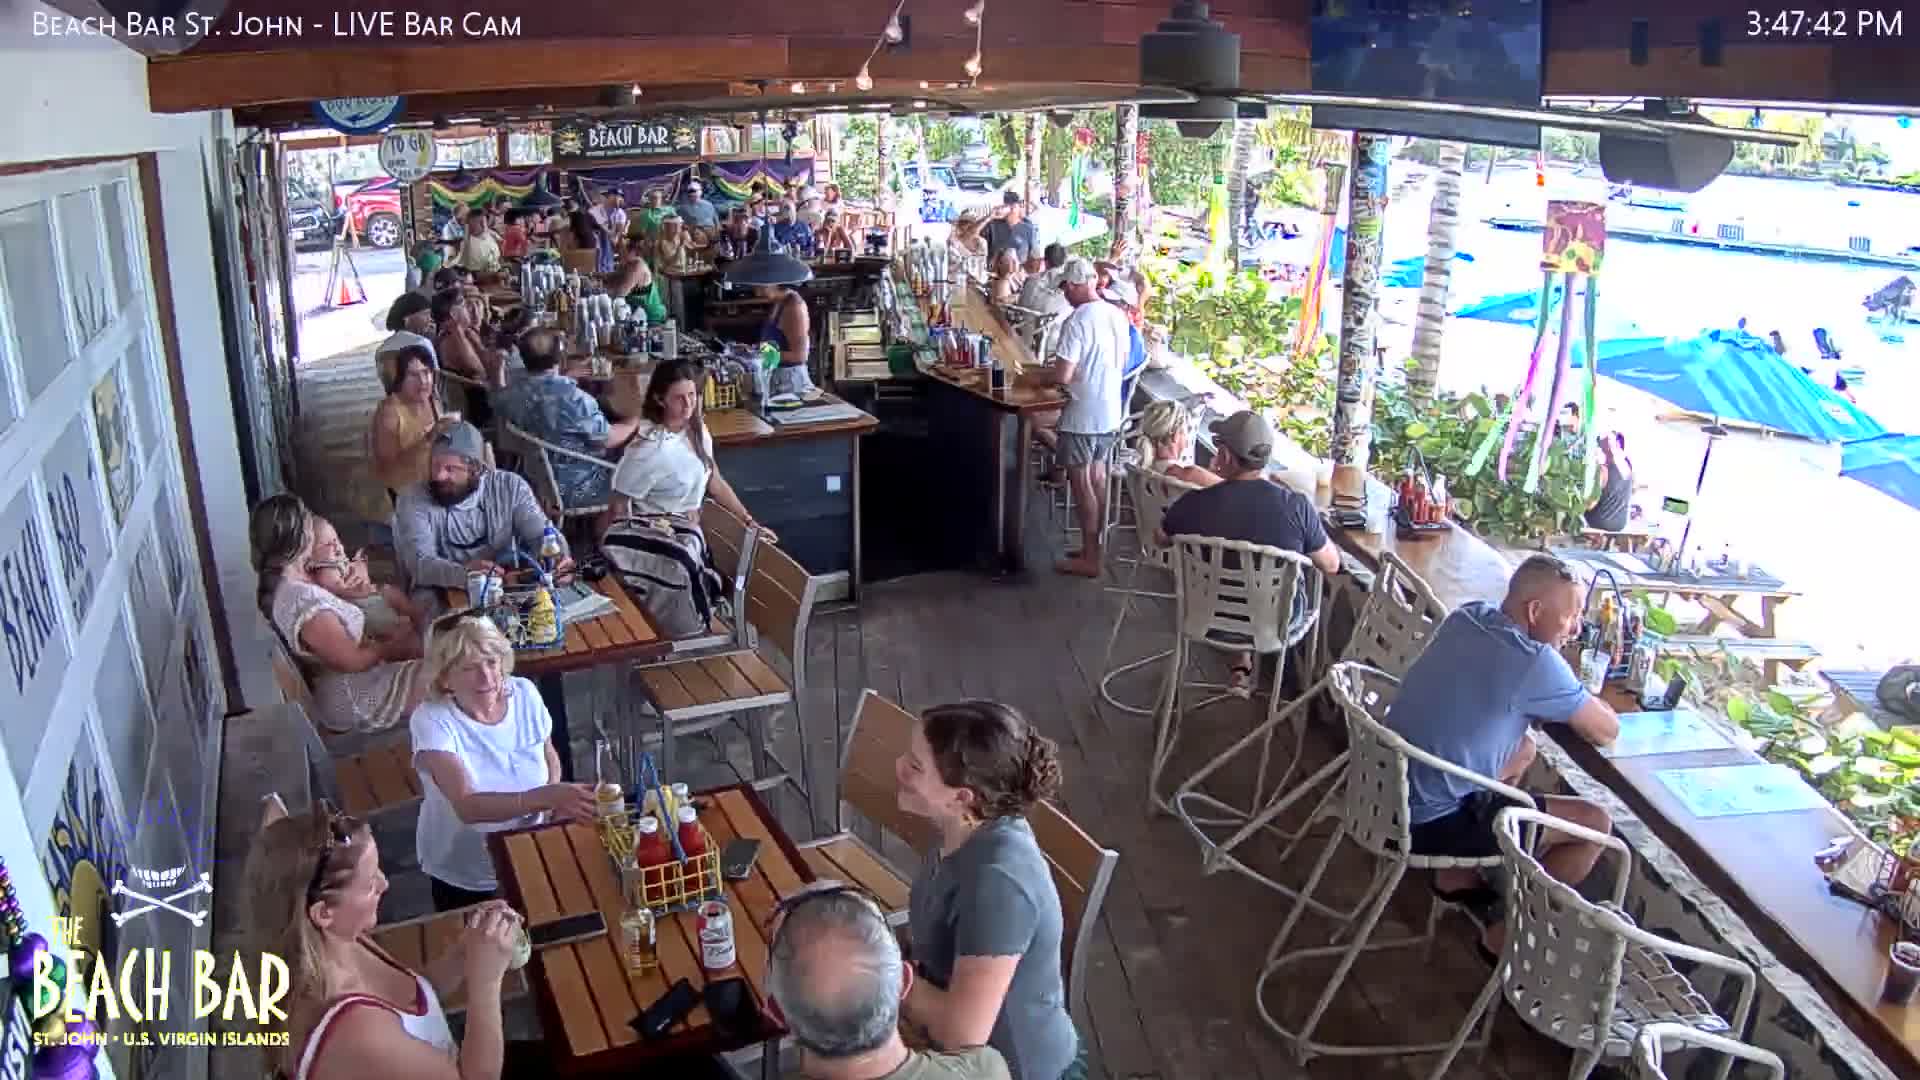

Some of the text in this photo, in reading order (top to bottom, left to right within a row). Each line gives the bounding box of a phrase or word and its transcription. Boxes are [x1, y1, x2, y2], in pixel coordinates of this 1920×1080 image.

[387, 131, 427, 154] TO GO
[588, 126, 669, 147] BEACH BAR
